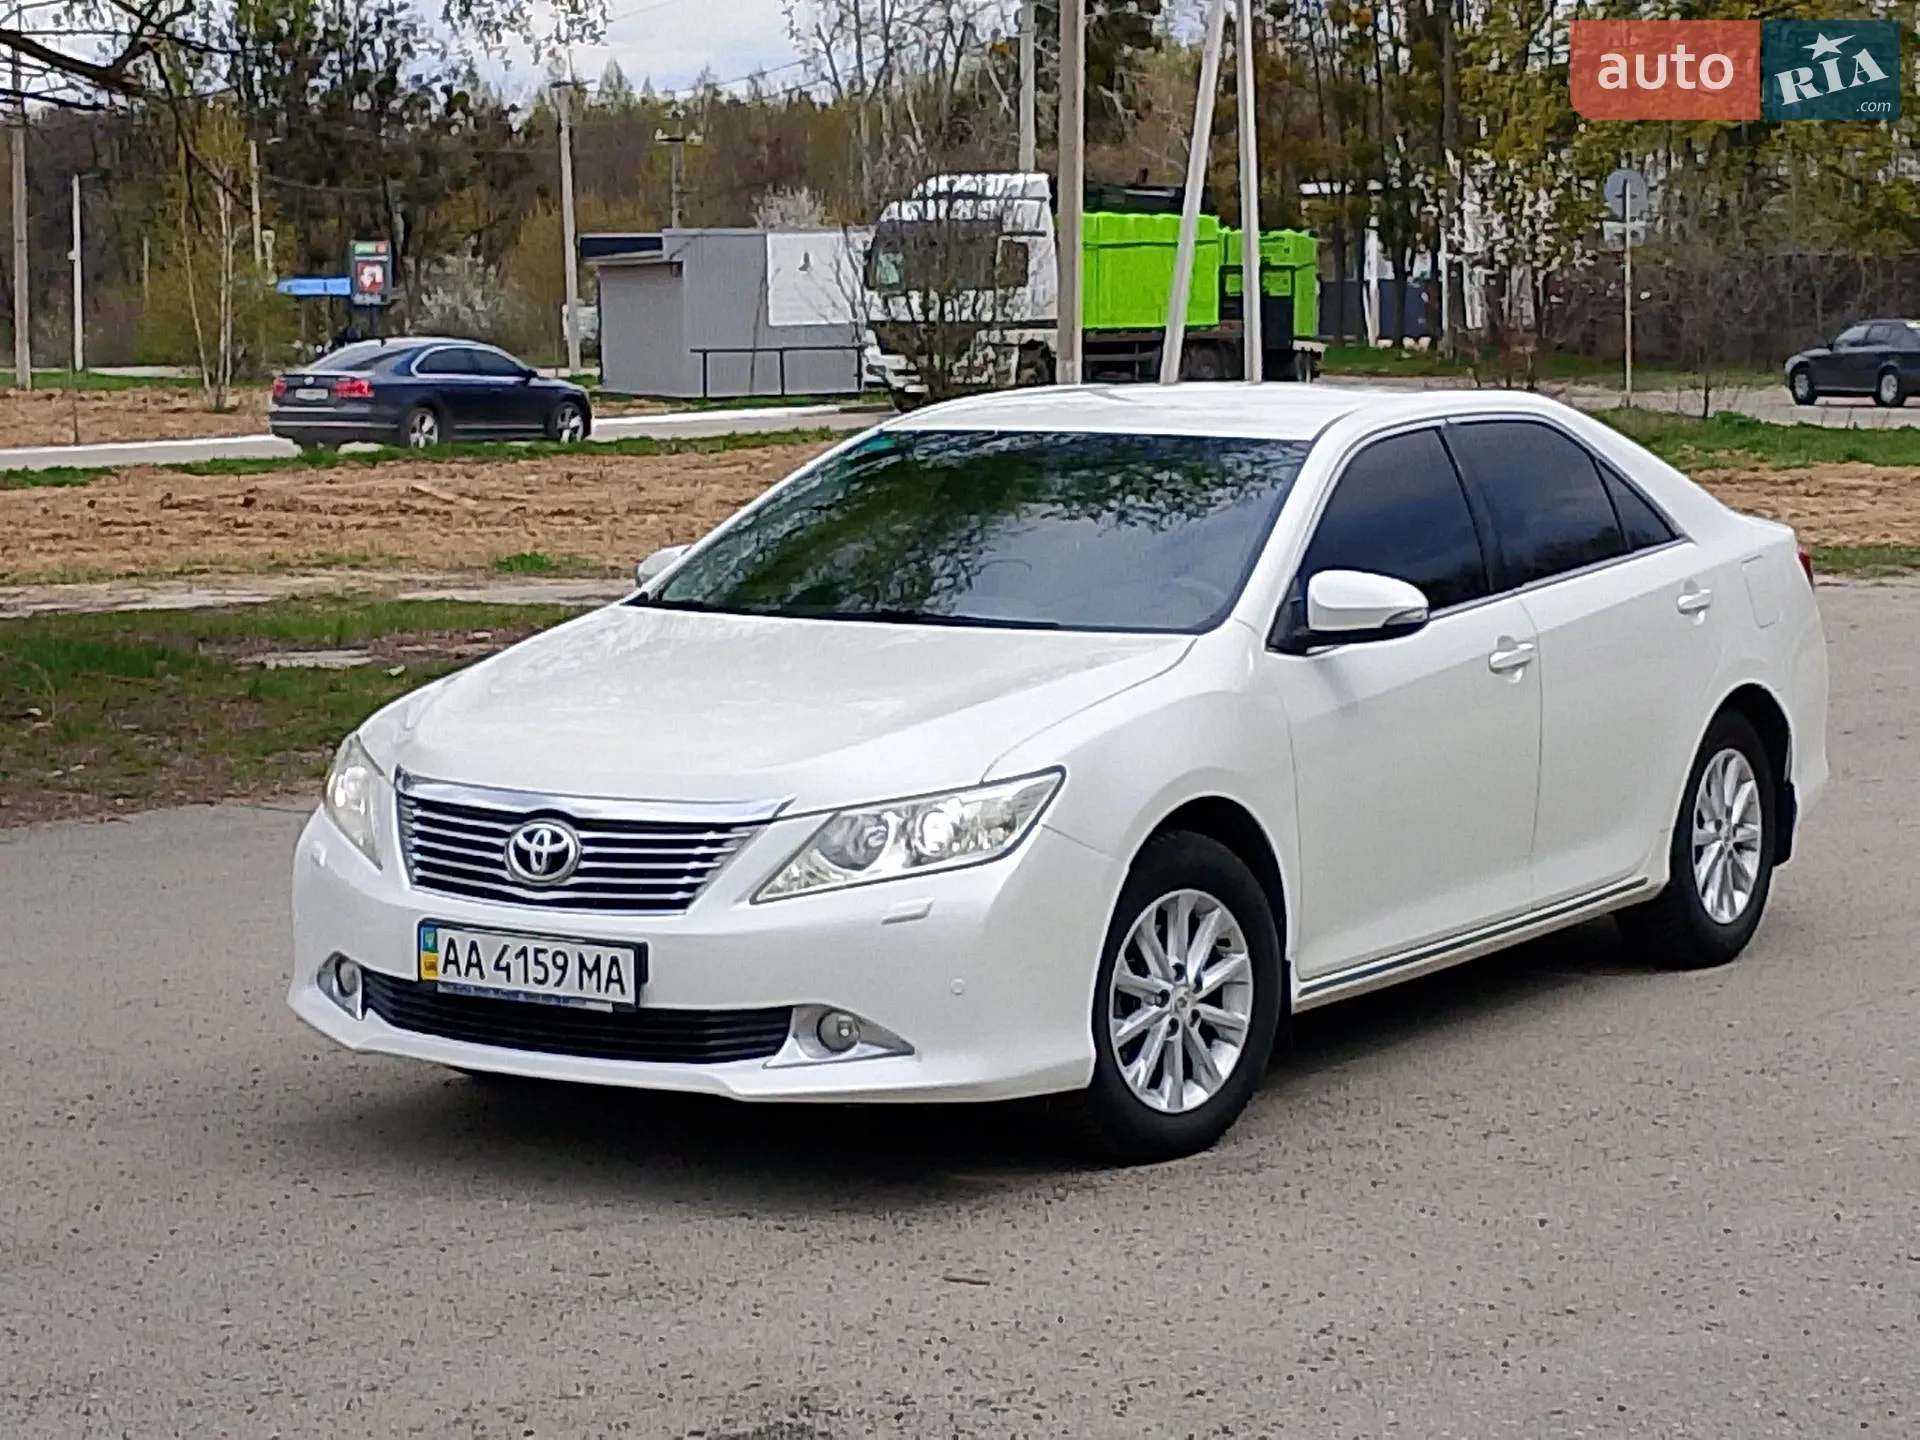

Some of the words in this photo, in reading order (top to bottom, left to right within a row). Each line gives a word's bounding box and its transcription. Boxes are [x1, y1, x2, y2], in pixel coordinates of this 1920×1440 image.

[441, 936, 486, 980] AA
[493, 943, 570, 988] 4159
[577, 951, 627, 996] MA
